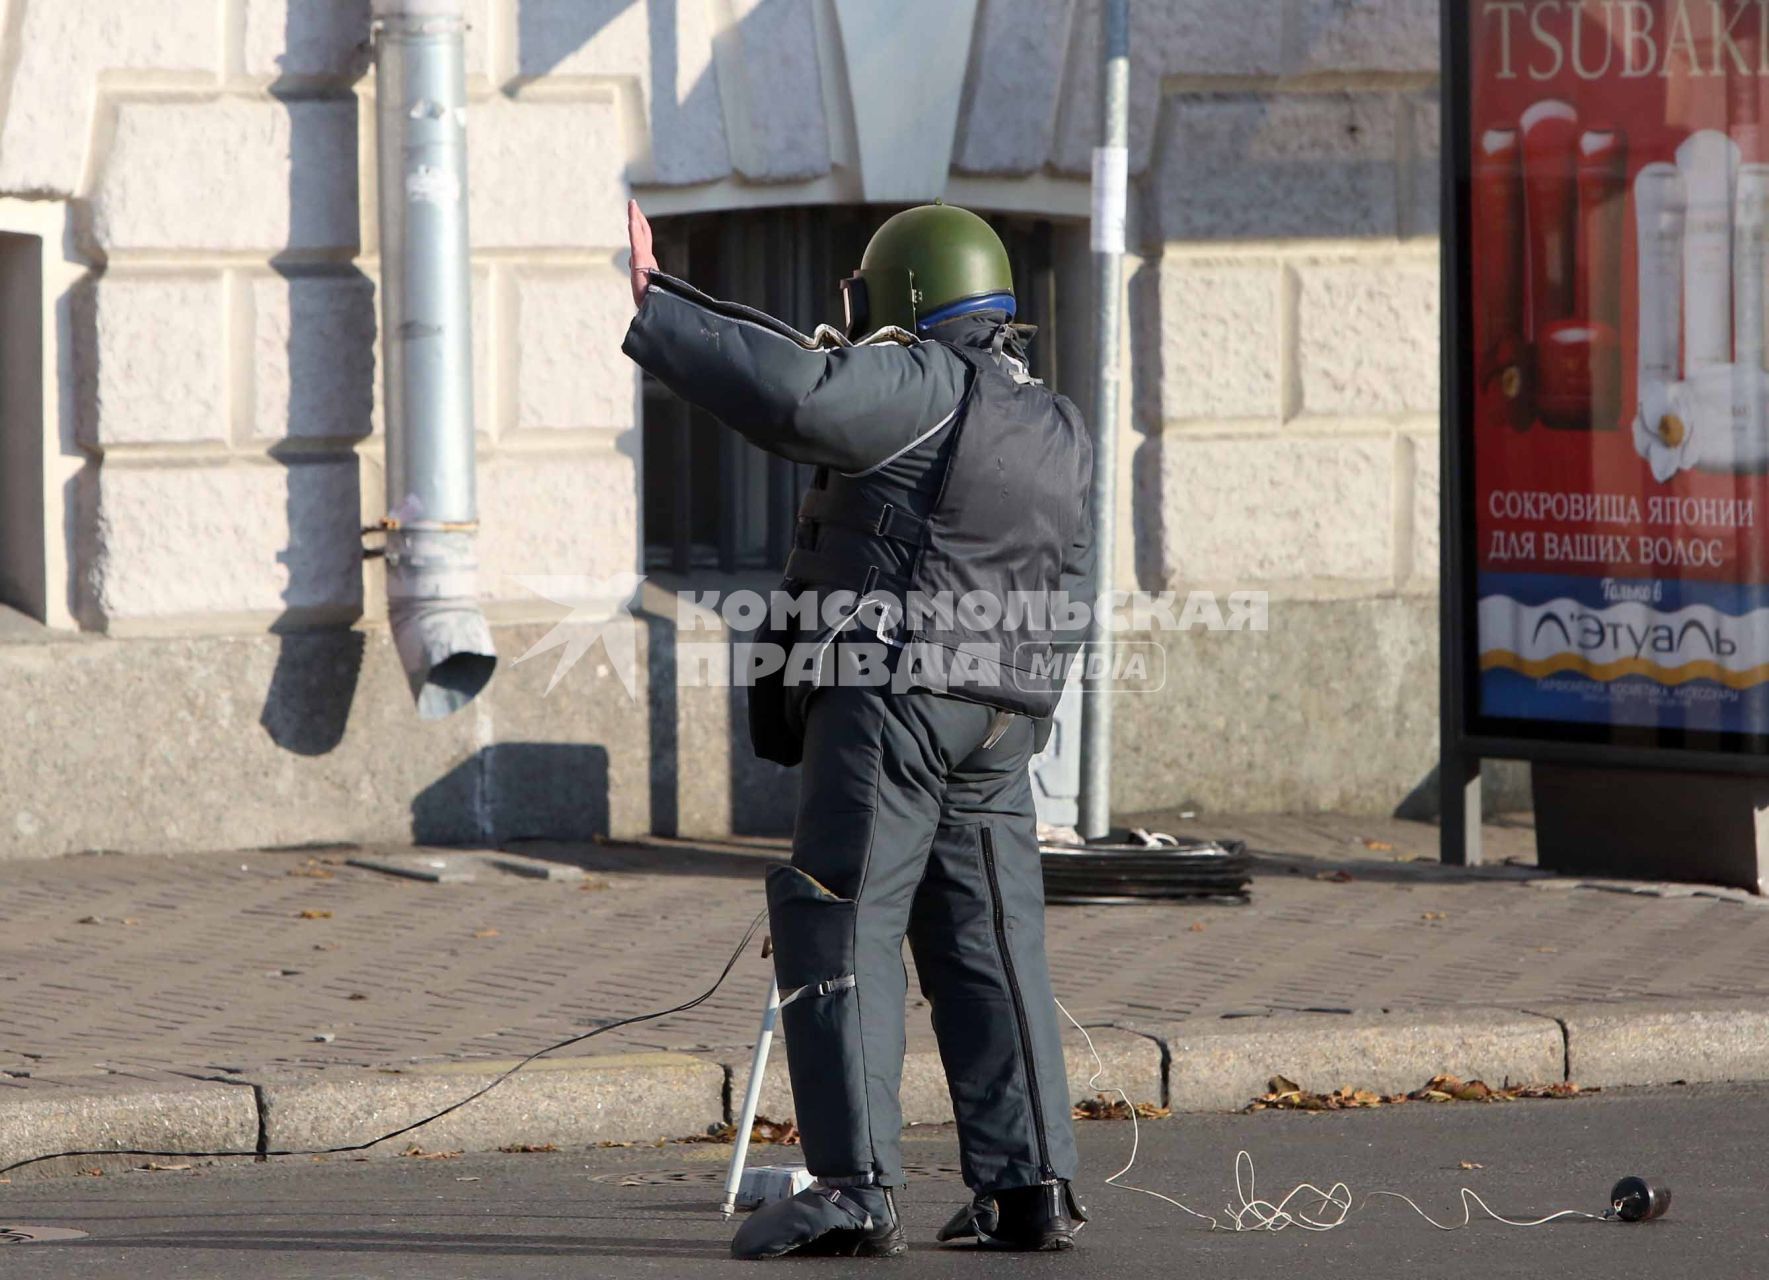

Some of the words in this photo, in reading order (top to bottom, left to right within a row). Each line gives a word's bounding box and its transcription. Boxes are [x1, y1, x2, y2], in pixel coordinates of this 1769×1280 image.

[1483, 0, 1769, 80] TSUBAKI
[1488, 490, 1641, 525] СОКРОВИЩА
[1648, 496, 1755, 527] ЯПОНИИ
[1488, 531, 1536, 560] ДЛЯ
[1544, 532, 1633, 563] ВАШИХ
[1639, 537, 1724, 566] ВОЛОС
